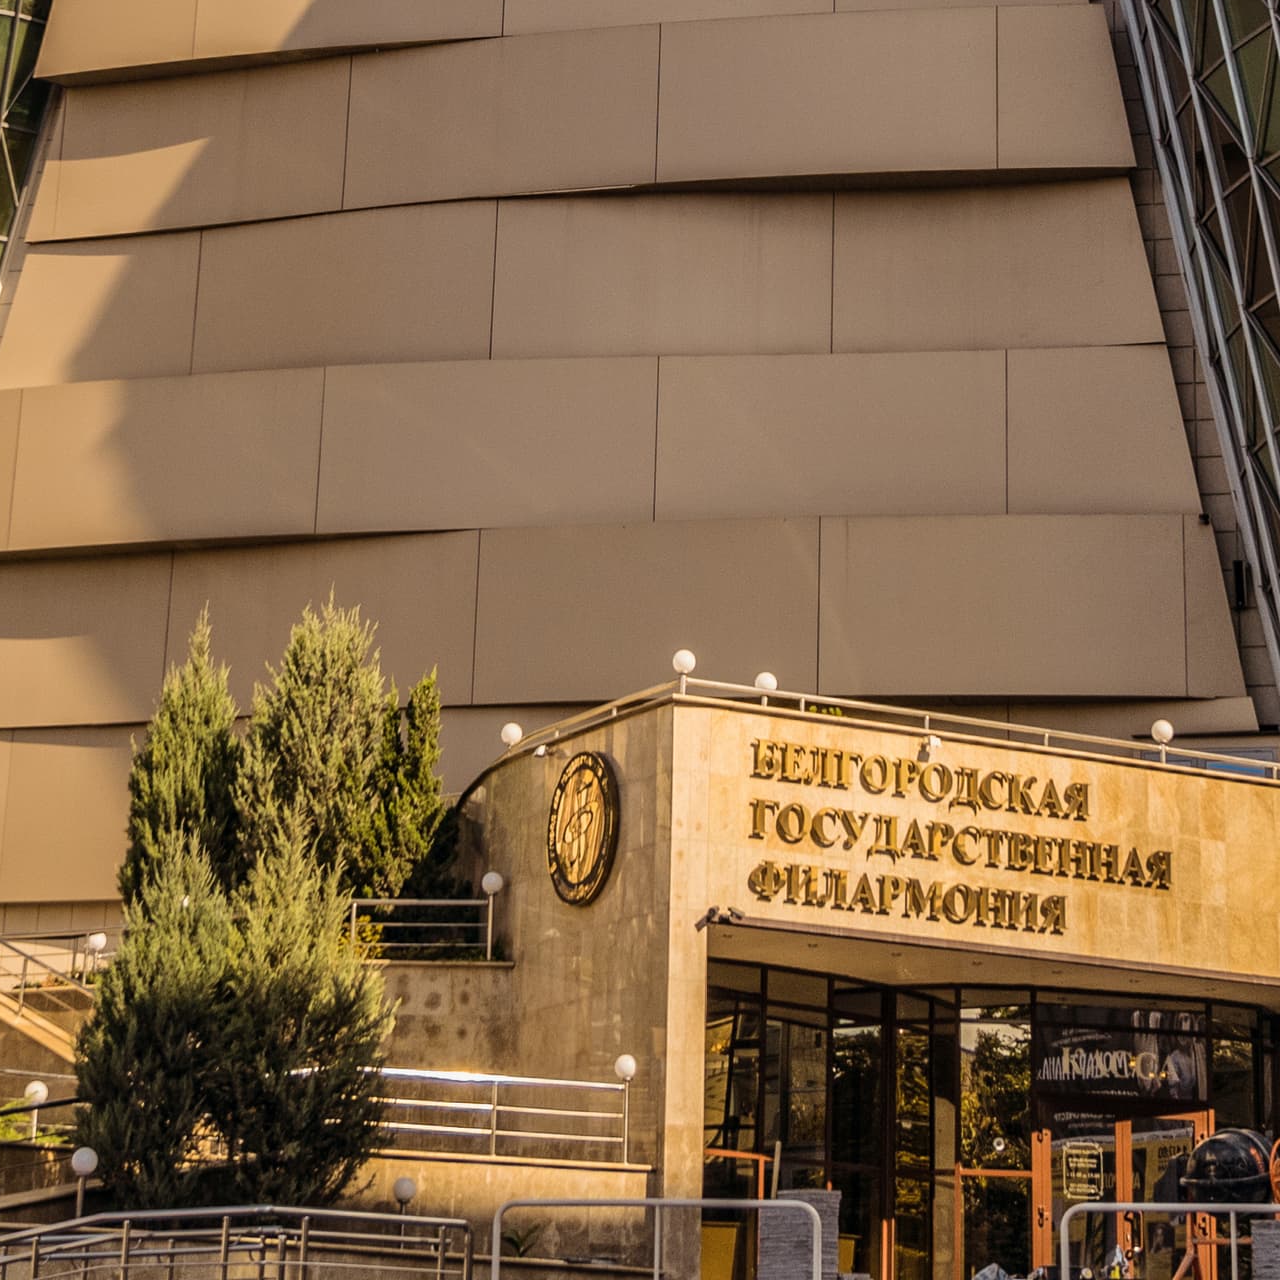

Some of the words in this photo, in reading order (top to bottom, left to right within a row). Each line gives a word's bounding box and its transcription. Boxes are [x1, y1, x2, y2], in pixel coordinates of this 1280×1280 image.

[749, 737, 1091, 821] БЕЛГОРОДСКАЯ
[748, 797, 1174, 890] ГОСУДАРСТВЕННАЯ
[747, 859, 1070, 935] ФИЛАРМОНИЯ
